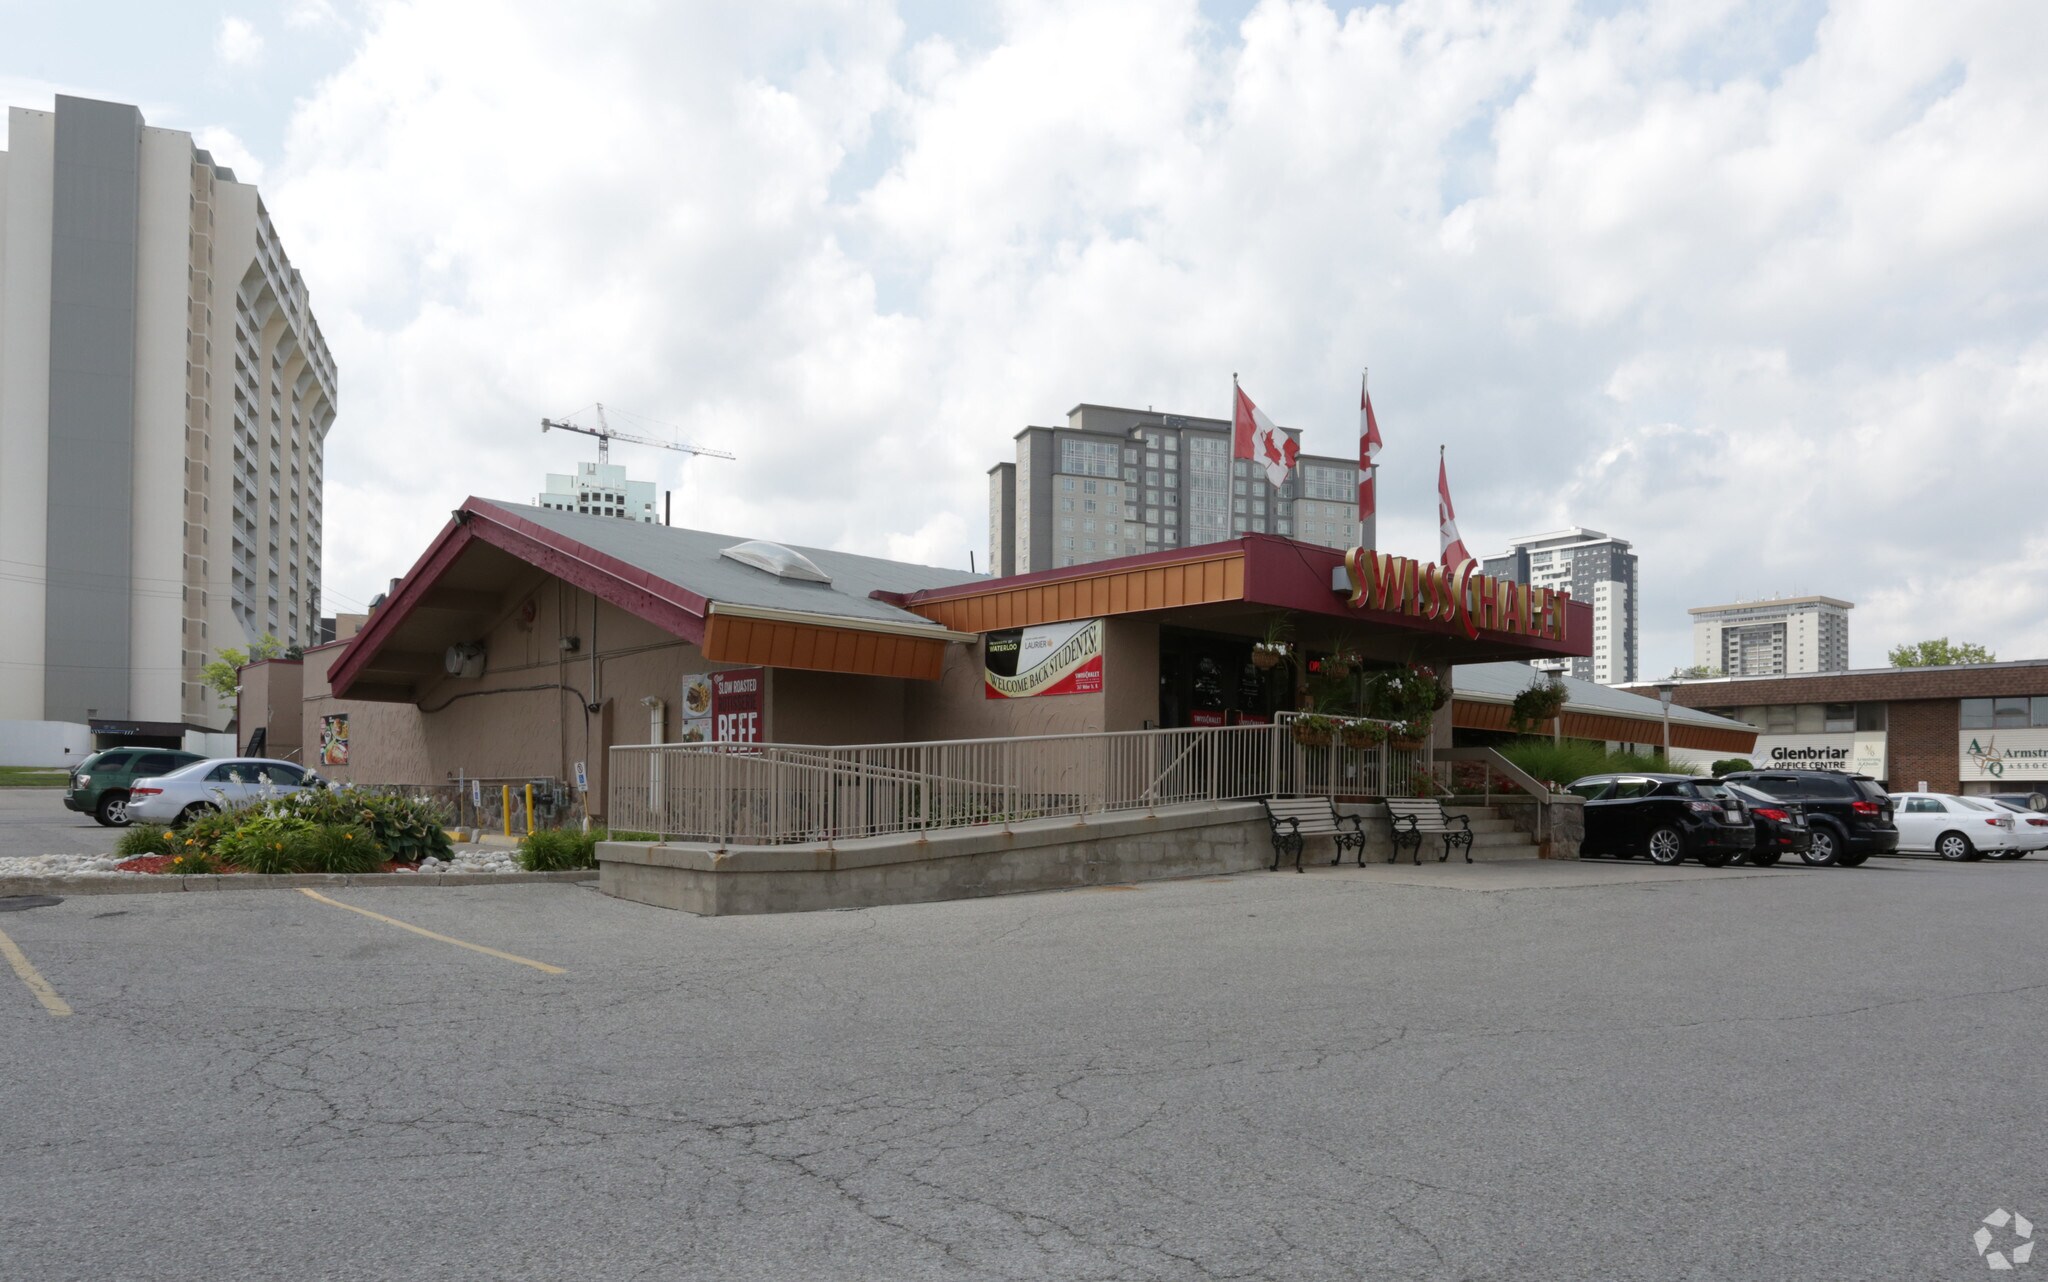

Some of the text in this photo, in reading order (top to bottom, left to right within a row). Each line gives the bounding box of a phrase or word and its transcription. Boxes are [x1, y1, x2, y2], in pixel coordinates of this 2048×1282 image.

[989, 643, 1018, 652] WATERLOO
[1024, 640, 1047, 650] LAURIER
[989, 625, 1097, 693] WELCOME BACK STUDENTS!
[719, 679, 757, 694] SLOW ROASTED
[718, 711, 758, 752] BEEF
[1771, 746, 1849, 760] Glenbriar
[1774, 761, 1846, 769] OFFICE CENTRE
